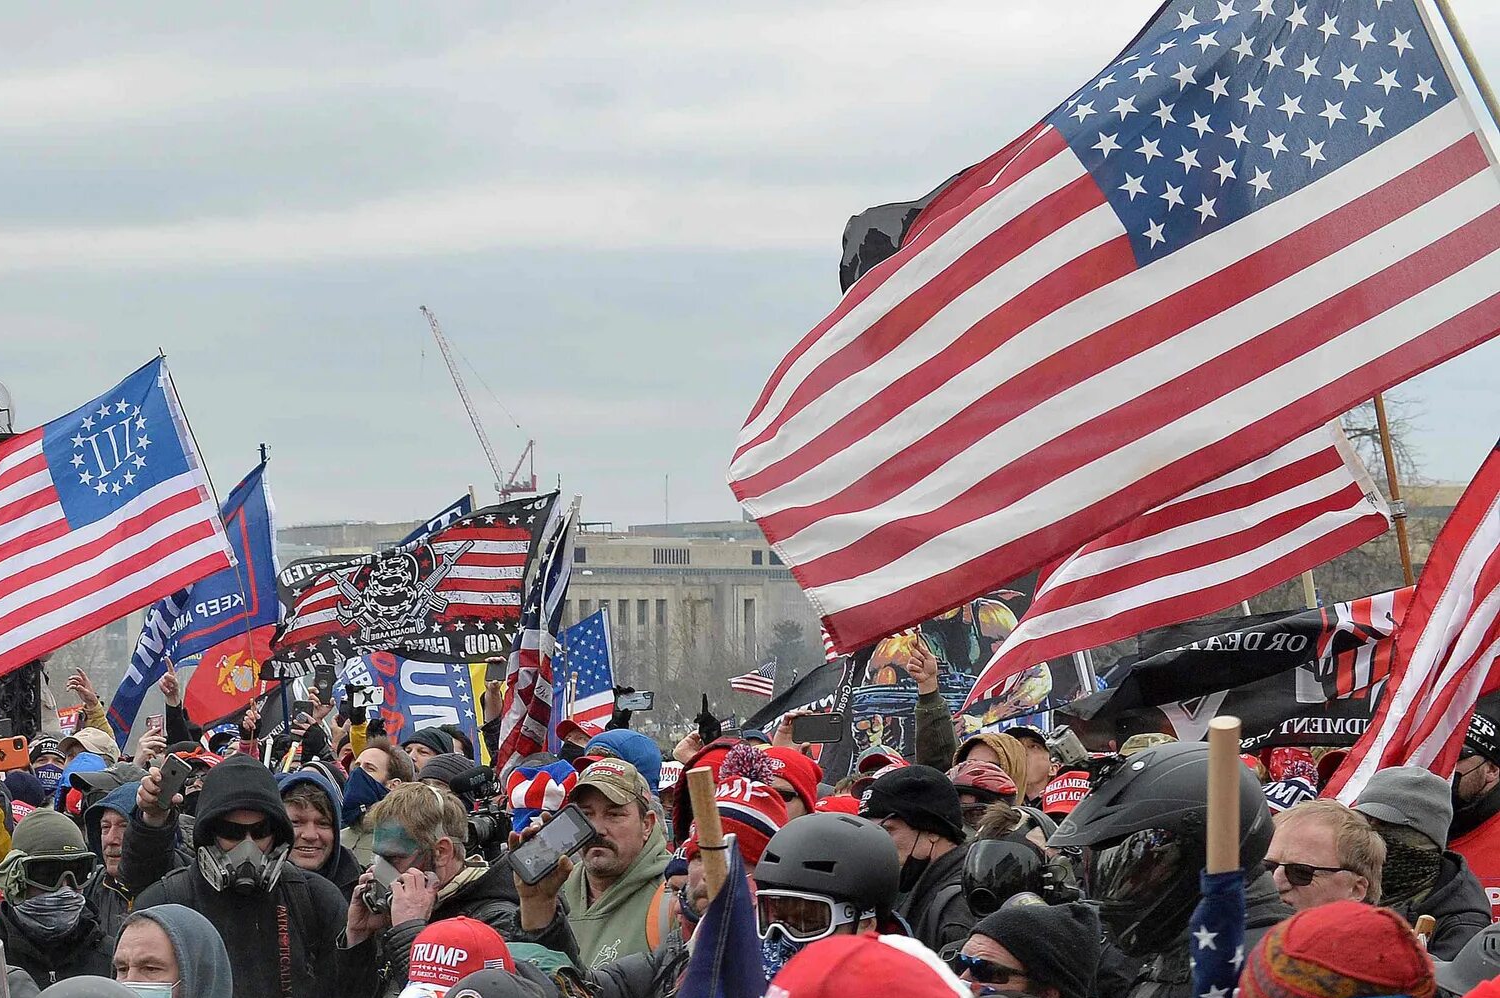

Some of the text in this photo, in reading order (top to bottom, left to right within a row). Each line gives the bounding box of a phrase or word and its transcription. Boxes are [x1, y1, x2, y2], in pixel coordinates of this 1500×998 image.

[85, 415, 138, 480] III
[1062, 778, 1091, 789] AMERI
[411, 943, 468, 967] TRUMP
